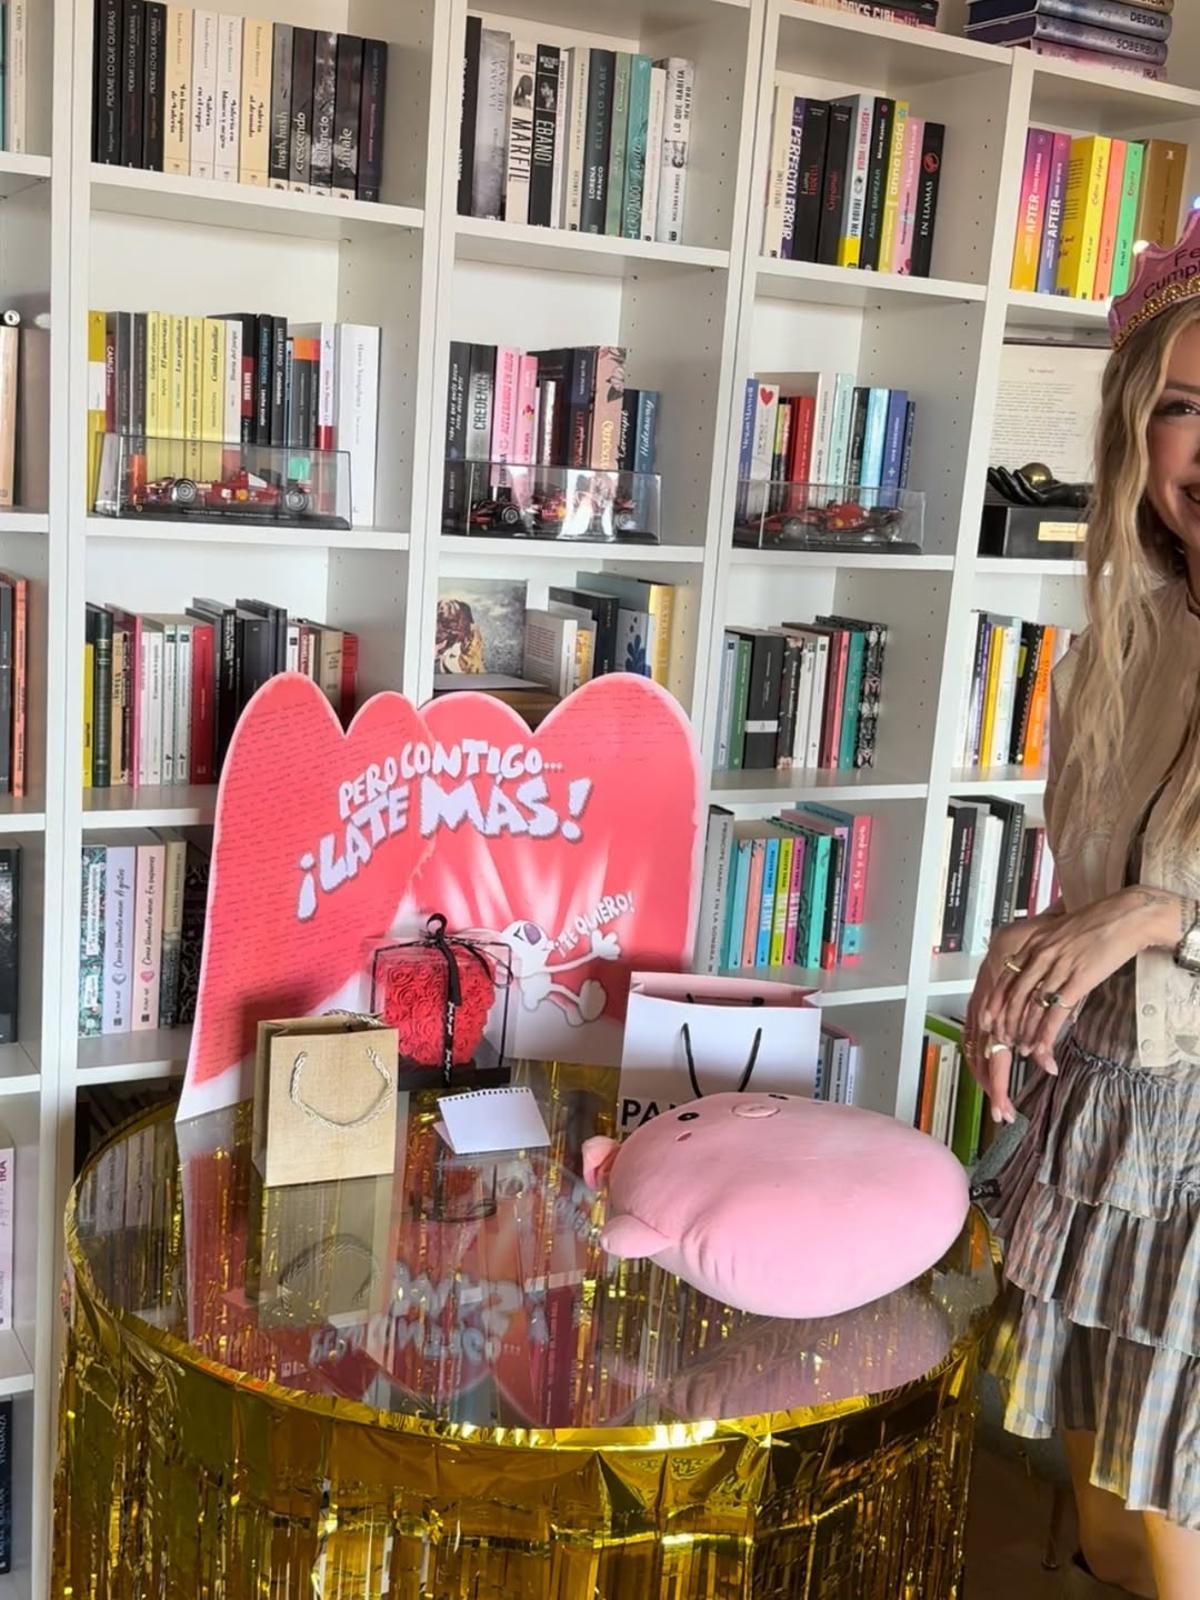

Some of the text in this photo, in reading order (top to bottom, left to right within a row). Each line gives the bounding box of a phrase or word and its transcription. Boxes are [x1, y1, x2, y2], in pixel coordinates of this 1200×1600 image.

[1130, 12, 1164, 28] DESIDIA
[595, 64, 607, 150] ELLA LO SABE
[674, 69, 685, 134] LO QUE HABITA
[508, 117, 532, 180] MARFIL
[889, 122, 905, 195] anna todd
[588, 165, 597, 200] LORENA
[596, 165, 604, 201] FRANCO
[781, 126, 802, 240] PERFECTO ERROR
[920, 180, 933, 236] EN LLAMAS
[1024, 194, 1041, 233] AFTER
[1046, 199, 1062, 238] AFTER
[106, 345, 115, 374] CAMUS
[640, 399, 655, 458] Hideaway
[338, 738, 564, 820] PERO CONTIGO...
[296, 771, 595, 922] ¡LATE MÁS!
[575, 890, 636, 938] QUIERO!
